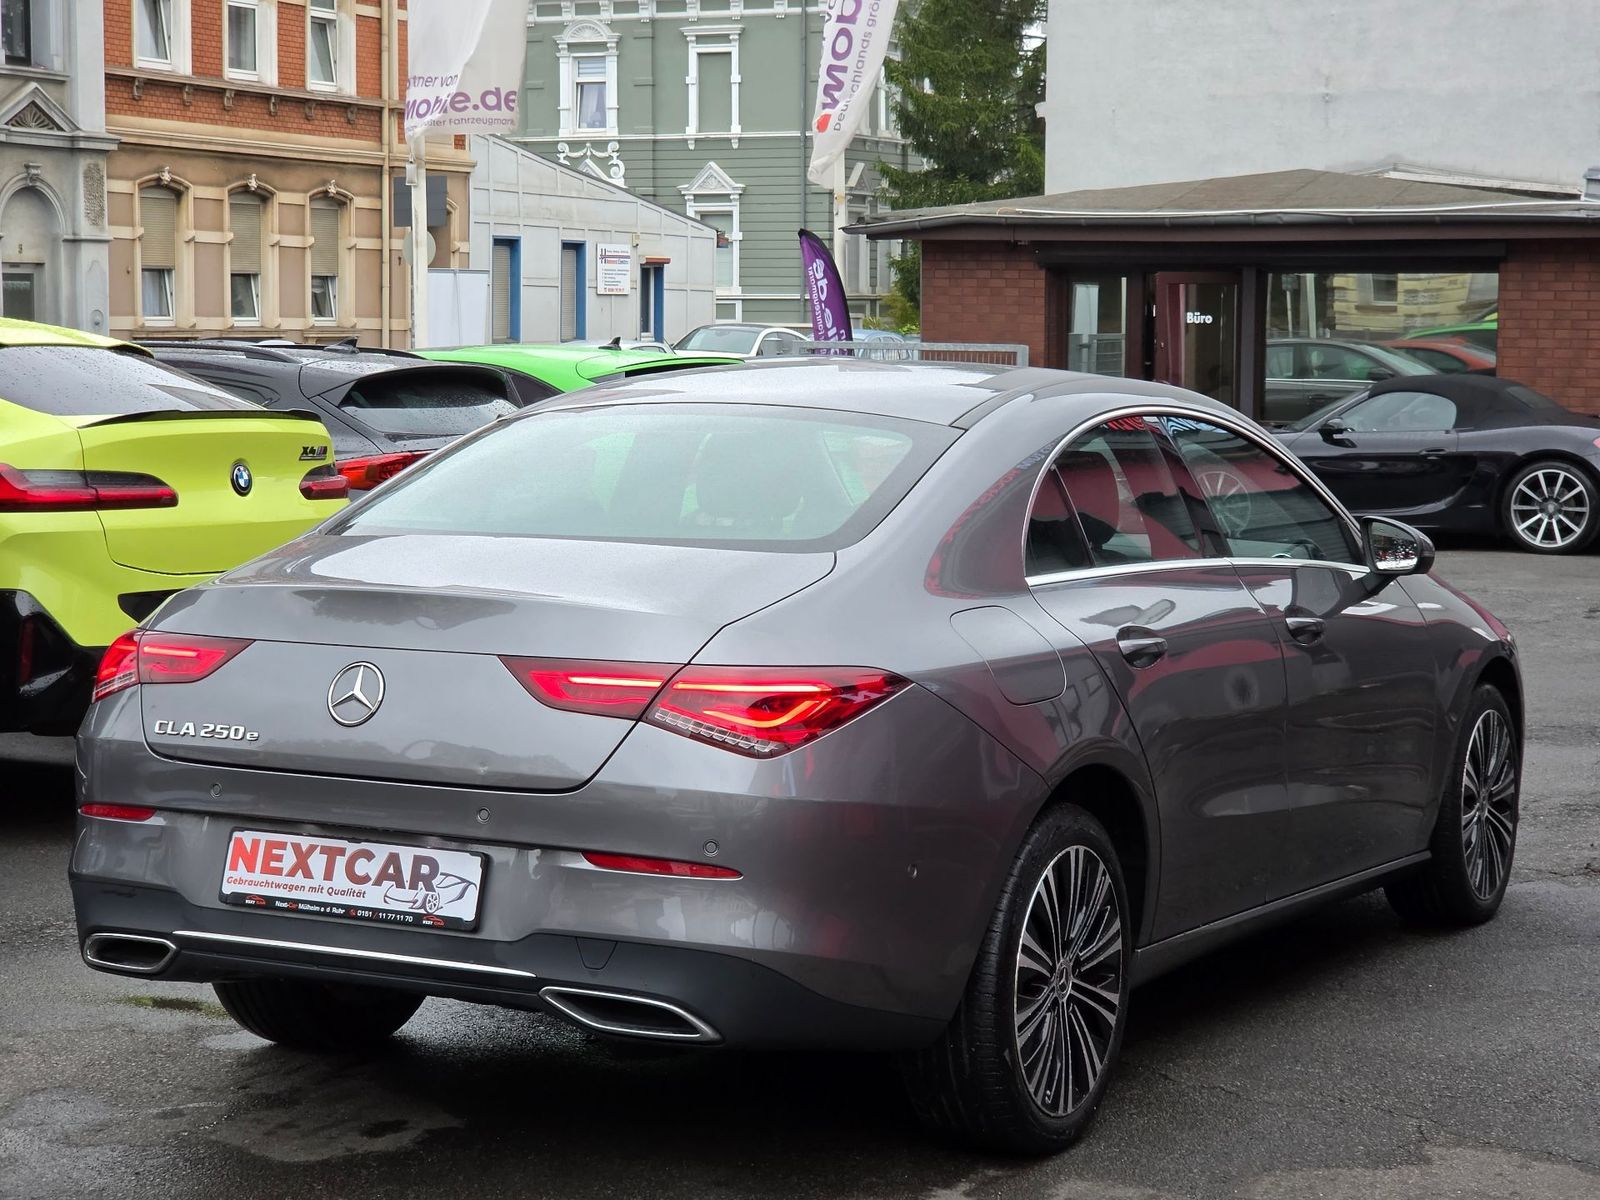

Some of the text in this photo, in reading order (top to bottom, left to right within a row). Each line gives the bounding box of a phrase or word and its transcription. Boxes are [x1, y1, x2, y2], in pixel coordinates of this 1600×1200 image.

[822, 0, 863, 110] mob
[833, 31, 872, 132] Deuchlands
[1186, 311, 1213, 324] Büro
[154, 720, 196, 736] CLA
[228, 836, 441, 892] NEXTCAR
[226, 876, 367, 899] Gebrauchtwagen mit Qualität
